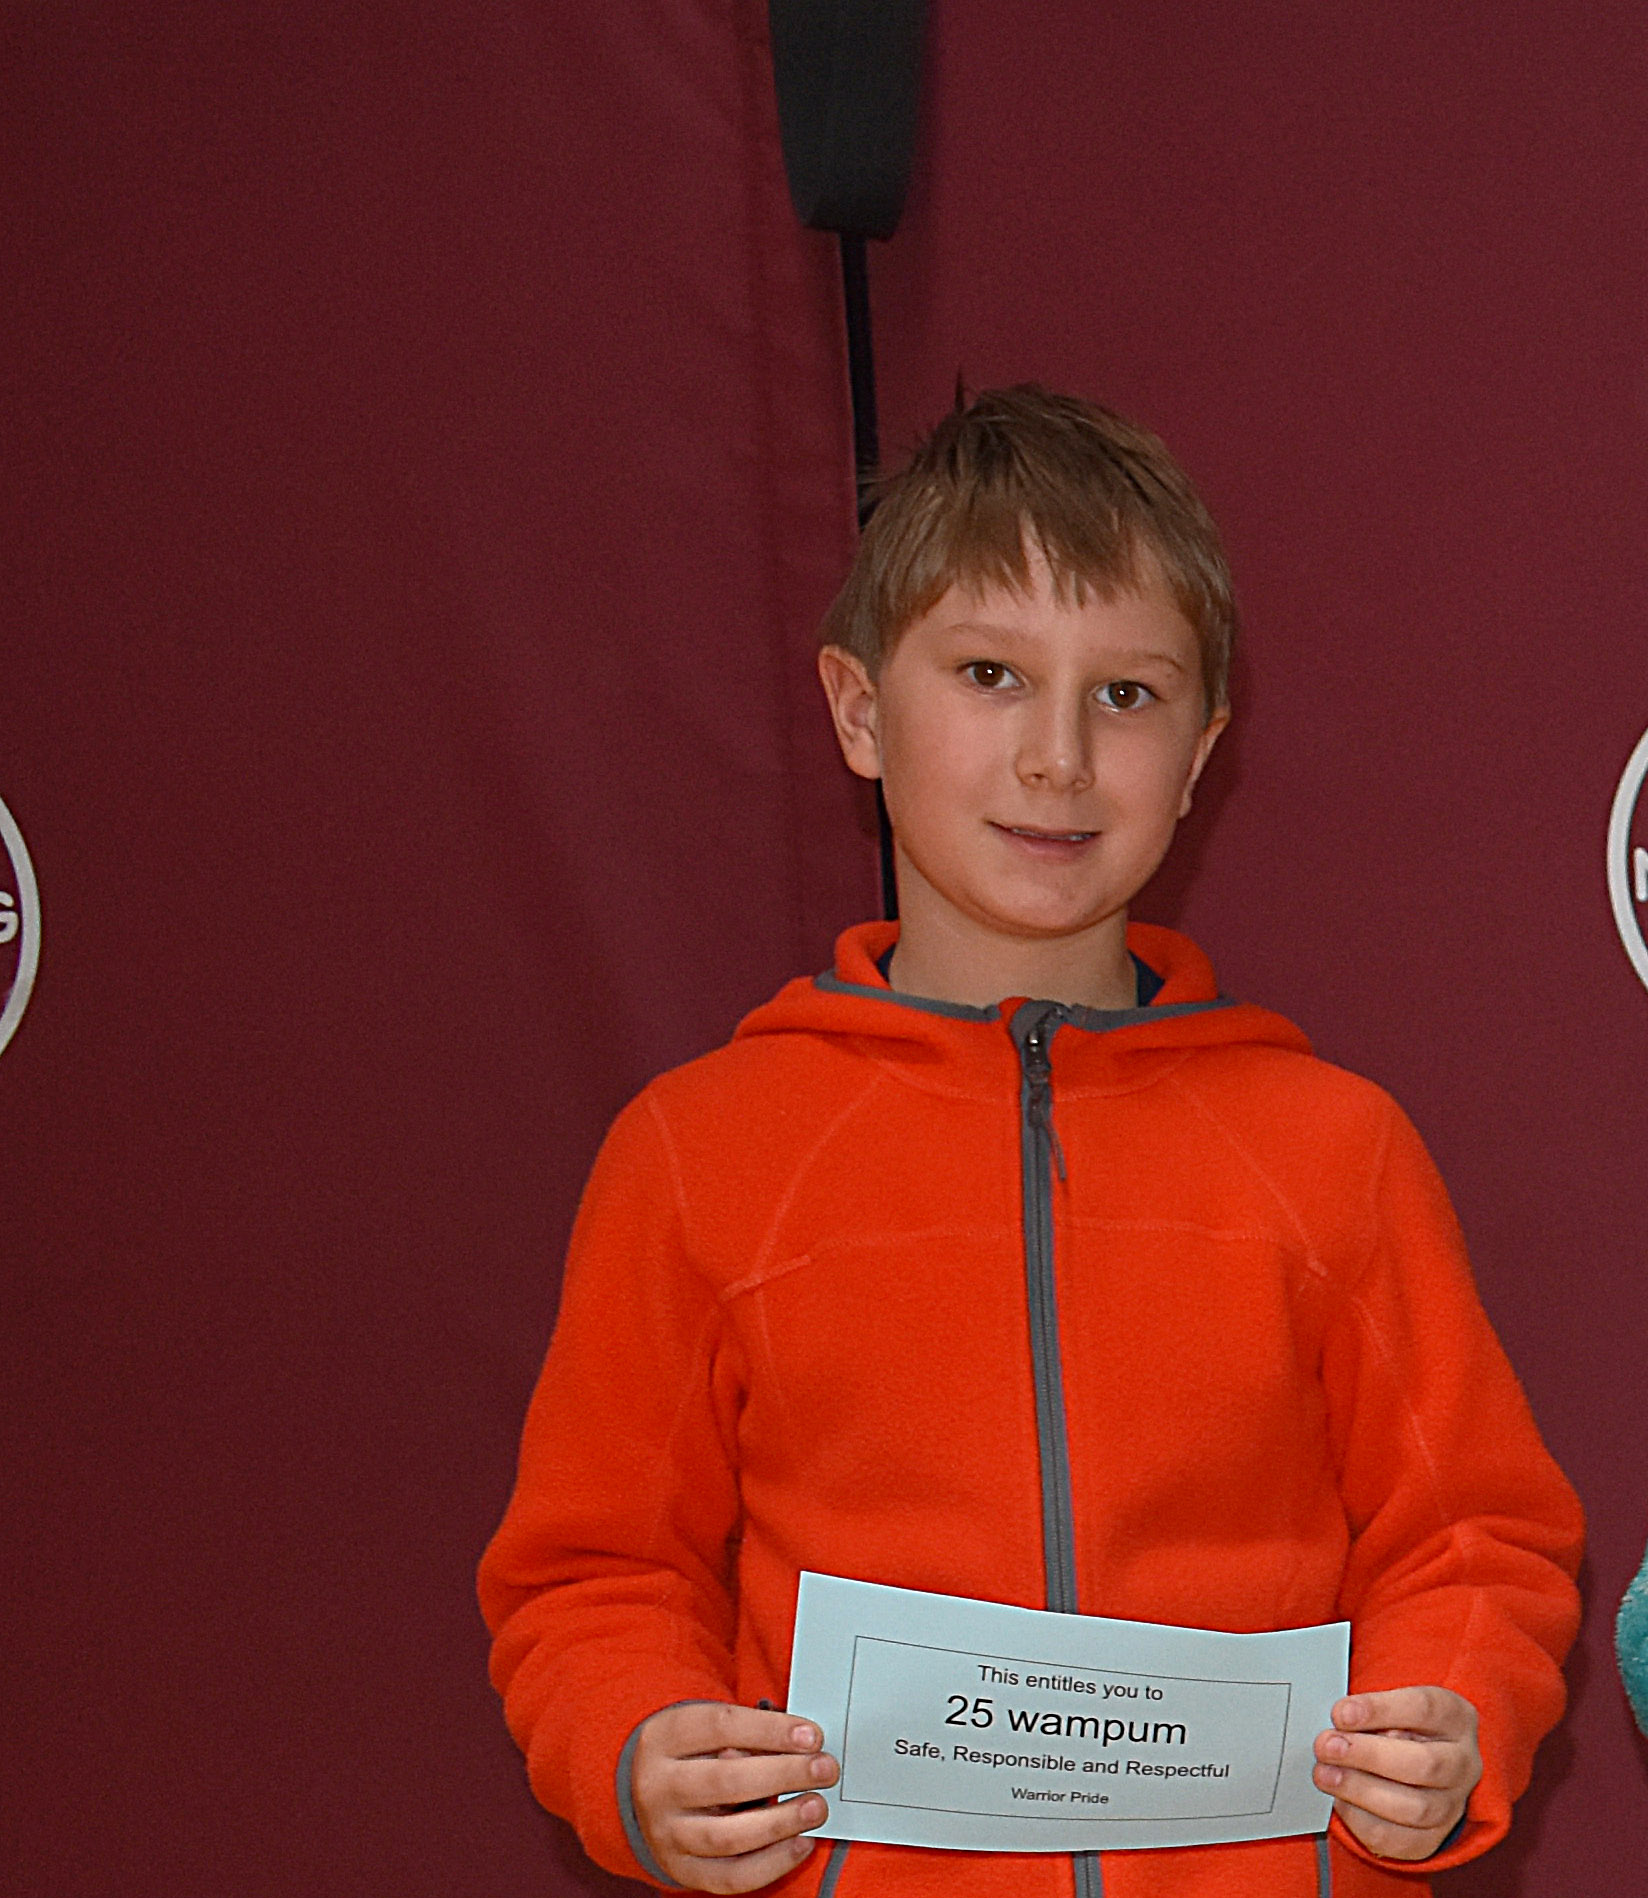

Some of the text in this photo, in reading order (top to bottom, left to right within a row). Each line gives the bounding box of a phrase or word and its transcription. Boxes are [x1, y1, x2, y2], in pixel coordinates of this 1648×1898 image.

[977, 1664, 1164, 1701] This entitles you to
[944, 1694, 1188, 1746] 25 wampum
[894, 1738, 1231, 1780] Safe, Responsible and Respectful
[1011, 1786, 1109, 1805] Warrior Pride
